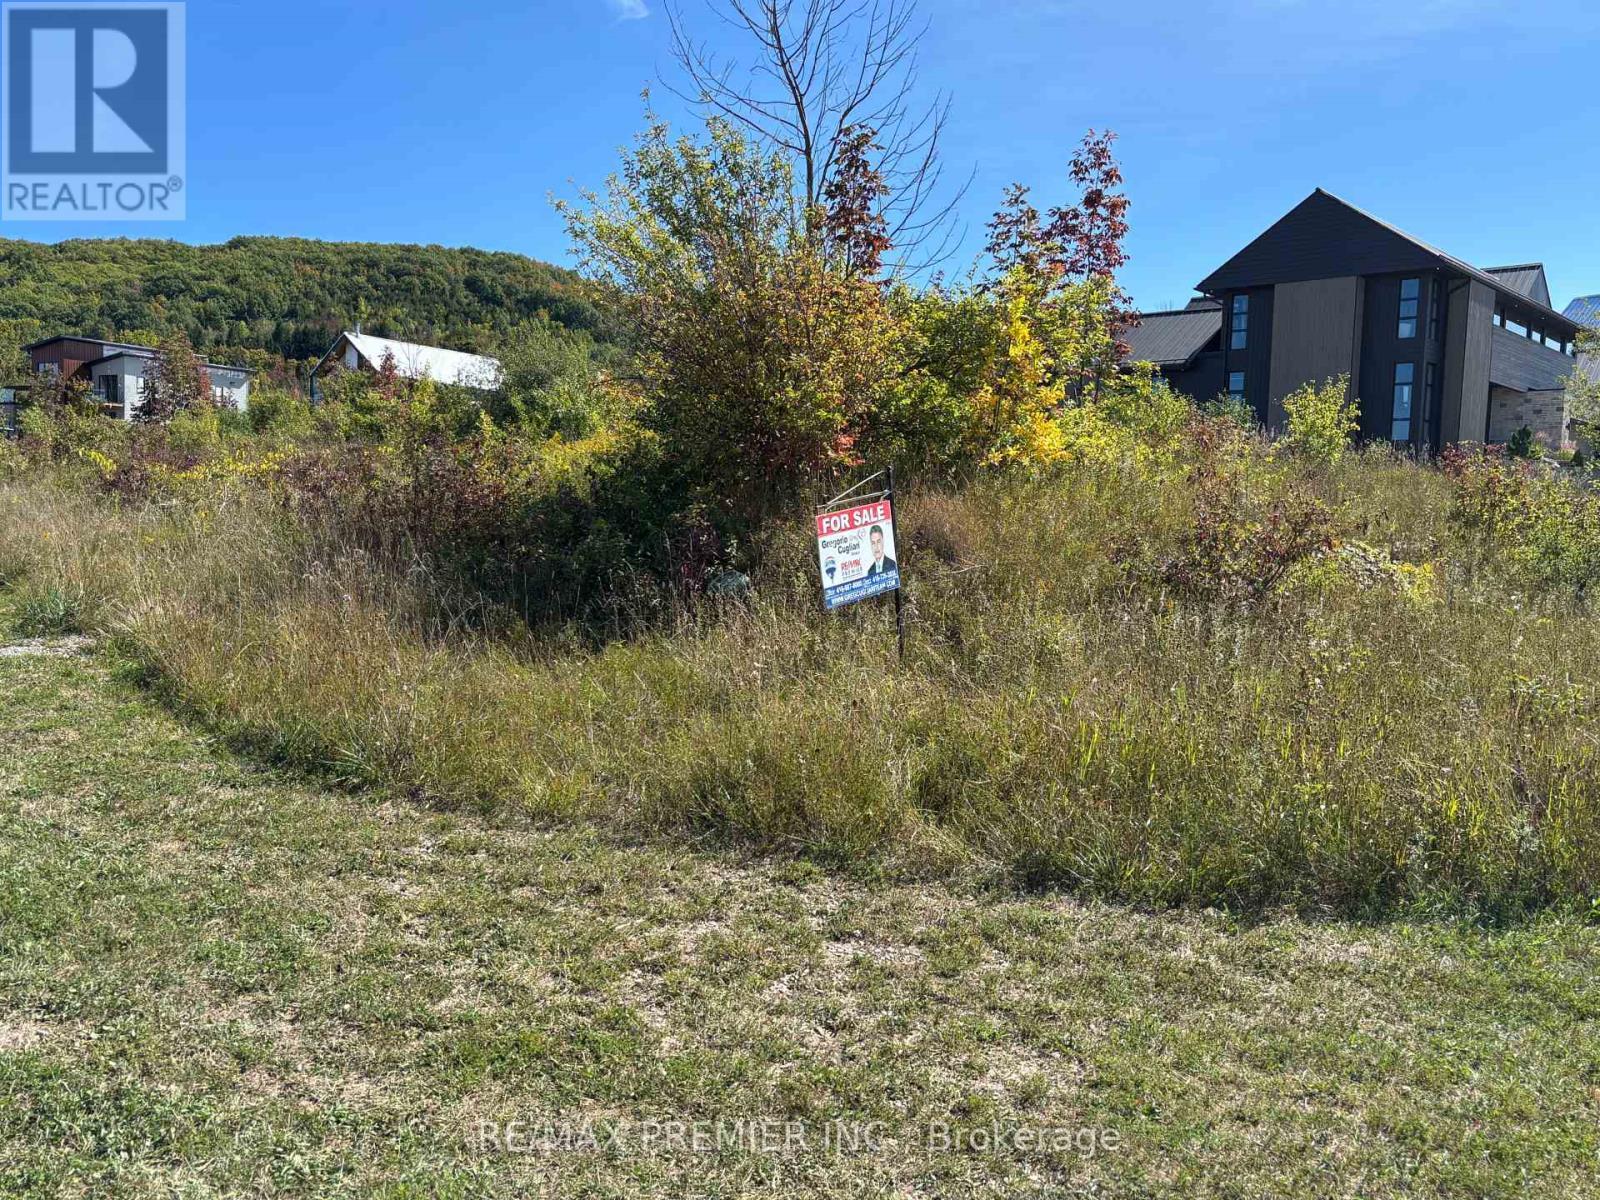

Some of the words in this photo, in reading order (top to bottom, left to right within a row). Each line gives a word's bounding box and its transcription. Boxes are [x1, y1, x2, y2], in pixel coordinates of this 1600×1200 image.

[822, 513, 851, 534] FOR
[853, 504, 885, 527] SALE
[821, 535, 849, 551] Gregorio
